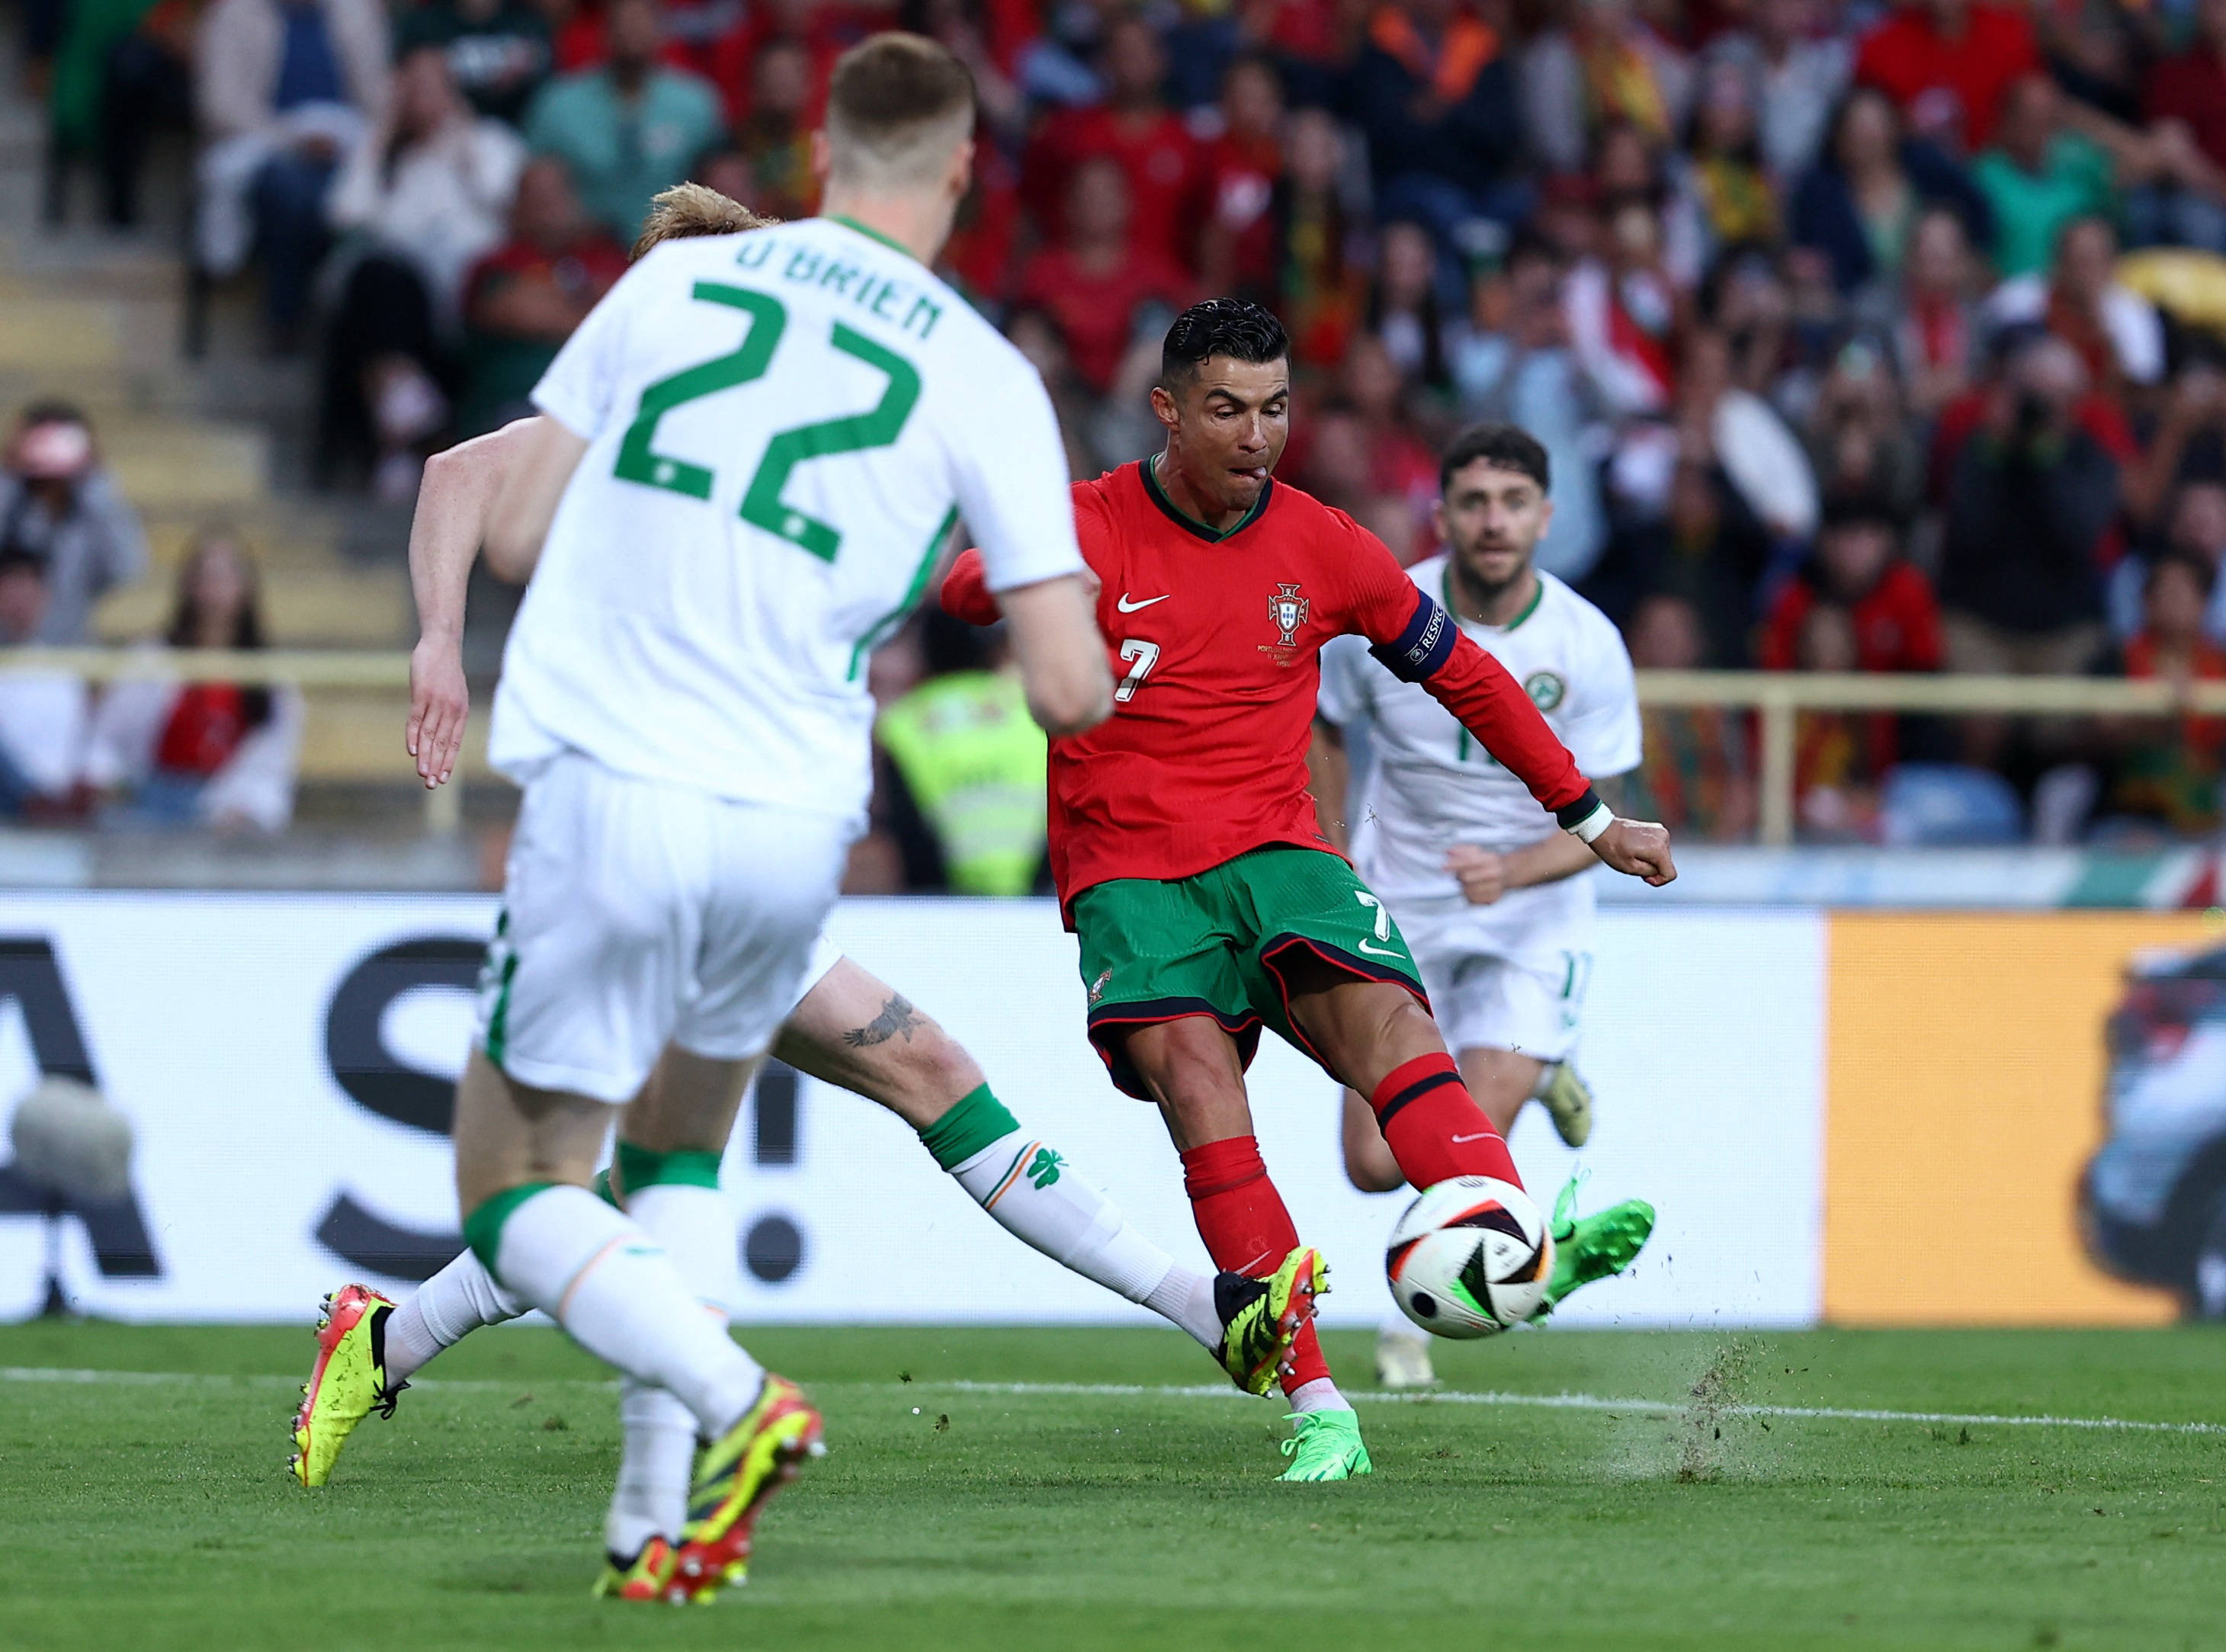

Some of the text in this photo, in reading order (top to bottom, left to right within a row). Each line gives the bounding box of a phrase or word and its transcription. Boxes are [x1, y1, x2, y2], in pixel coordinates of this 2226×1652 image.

[735, 238, 943, 340] O'BRIEN
[612, 281, 922, 564] 22
[1115, 638, 1160, 702] 7
[1354, 890, 1390, 942] 7
